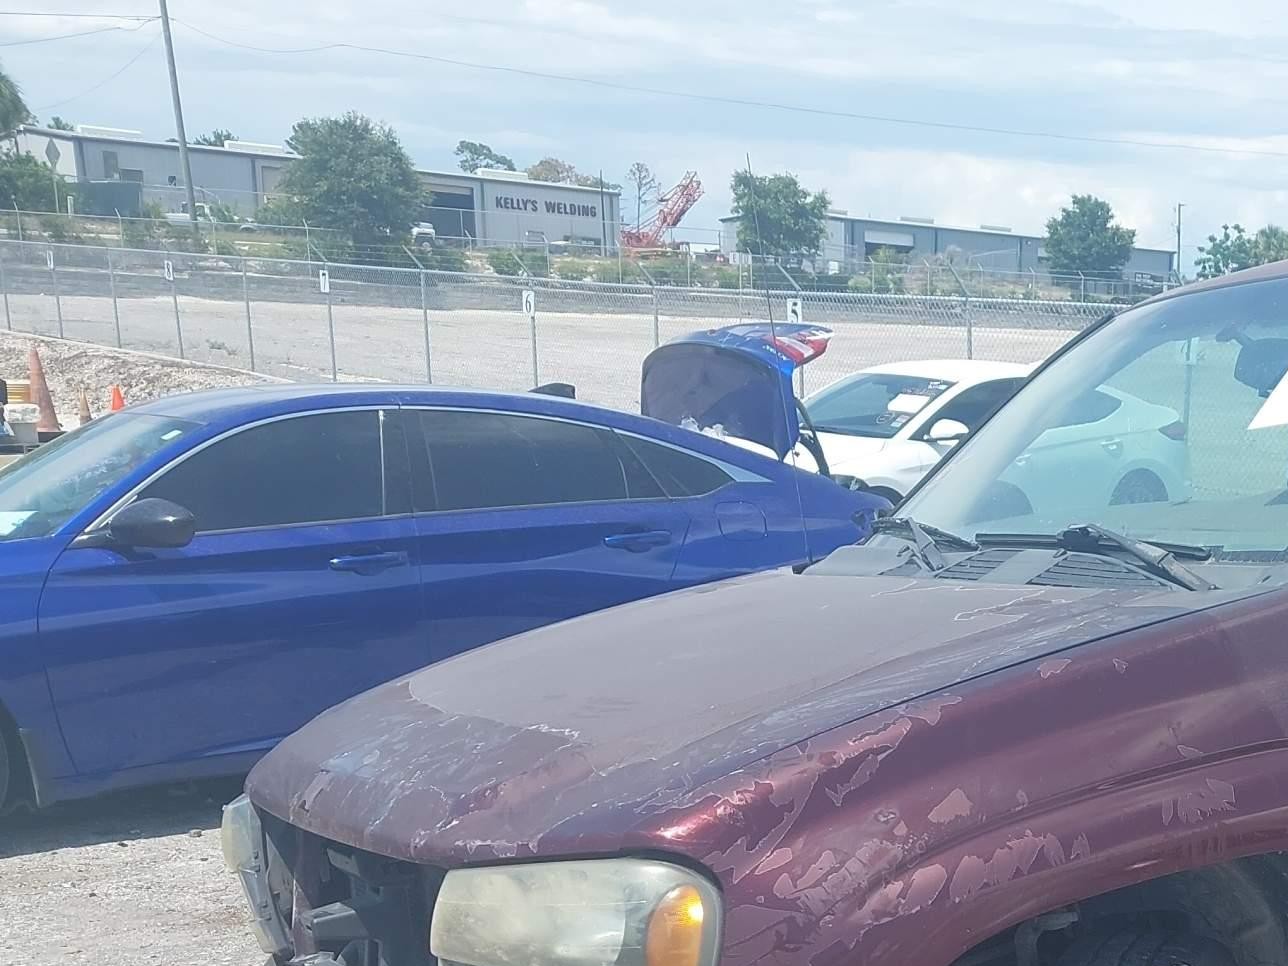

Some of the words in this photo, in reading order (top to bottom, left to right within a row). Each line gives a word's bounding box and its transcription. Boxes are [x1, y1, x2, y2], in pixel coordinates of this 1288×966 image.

[495, 196, 538, 212] KELLY'S
[545, 201, 597, 217] WELDING
[525, 293, 532, 313] 6
[790, 302, 799, 323] 5
